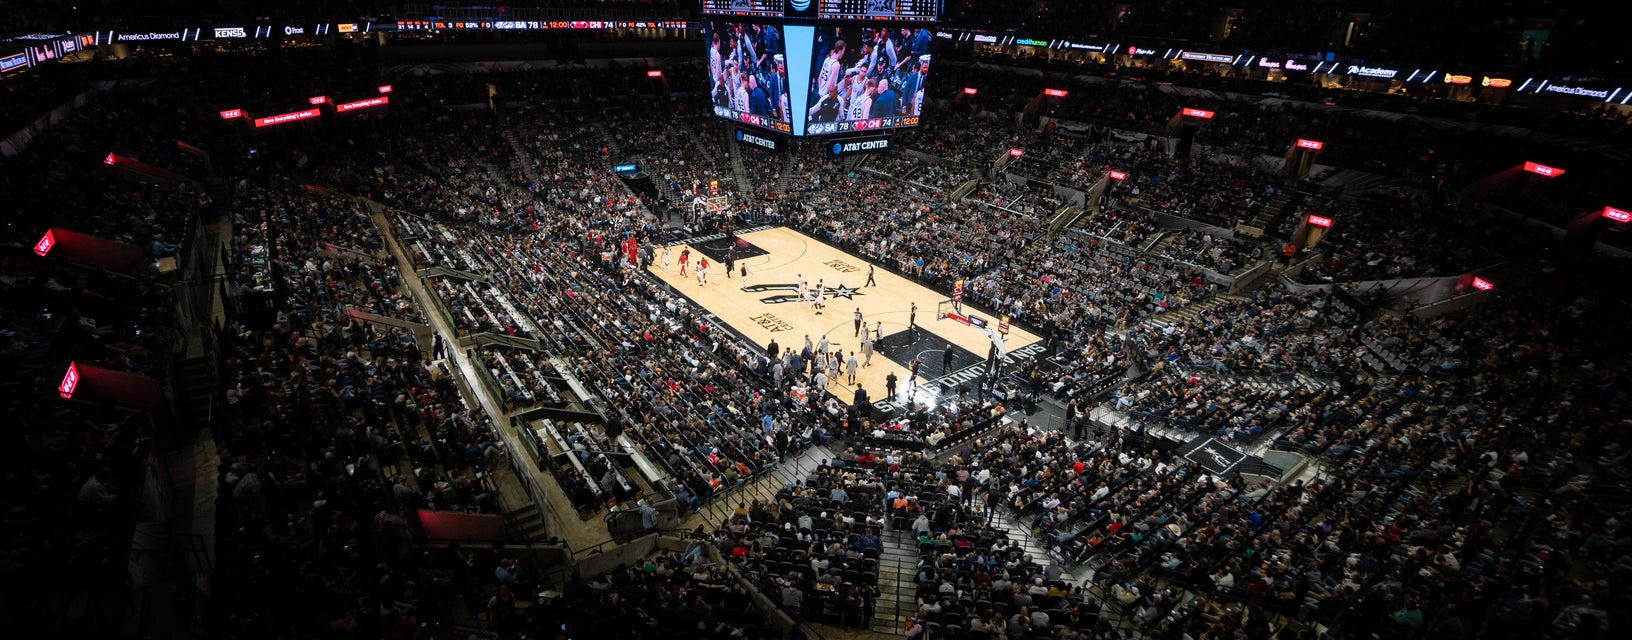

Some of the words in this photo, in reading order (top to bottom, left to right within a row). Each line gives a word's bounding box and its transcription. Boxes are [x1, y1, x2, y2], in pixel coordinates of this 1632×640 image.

[528, 21, 539, 29] 78
[118, 33, 149, 41] Americus
[150, 32, 179, 40] Diamond
[1359, 66, 1397, 77] Academy
[1547, 84, 1575, 95] Americus
[1575, 86, 1608, 98] Diamond
[760, 117, 768, 126] 74
[776, 121, 791, 132] 12:00
[824, 123, 836, 132] SA
[839, 122, 849, 130] 78
[868, 119, 880, 128] CHI
[882, 118, 892, 127] 74
[902, 117, 919, 125] 12:00
[743, 133, 755, 144] AT&T
[755, 136, 775, 149] CENTER
[843, 141, 861, 152] AT&T
[861, 140, 888, 150] CENTER
[749, 316, 785, 333] AT&T
[1010, 343, 1047, 360] SAN
